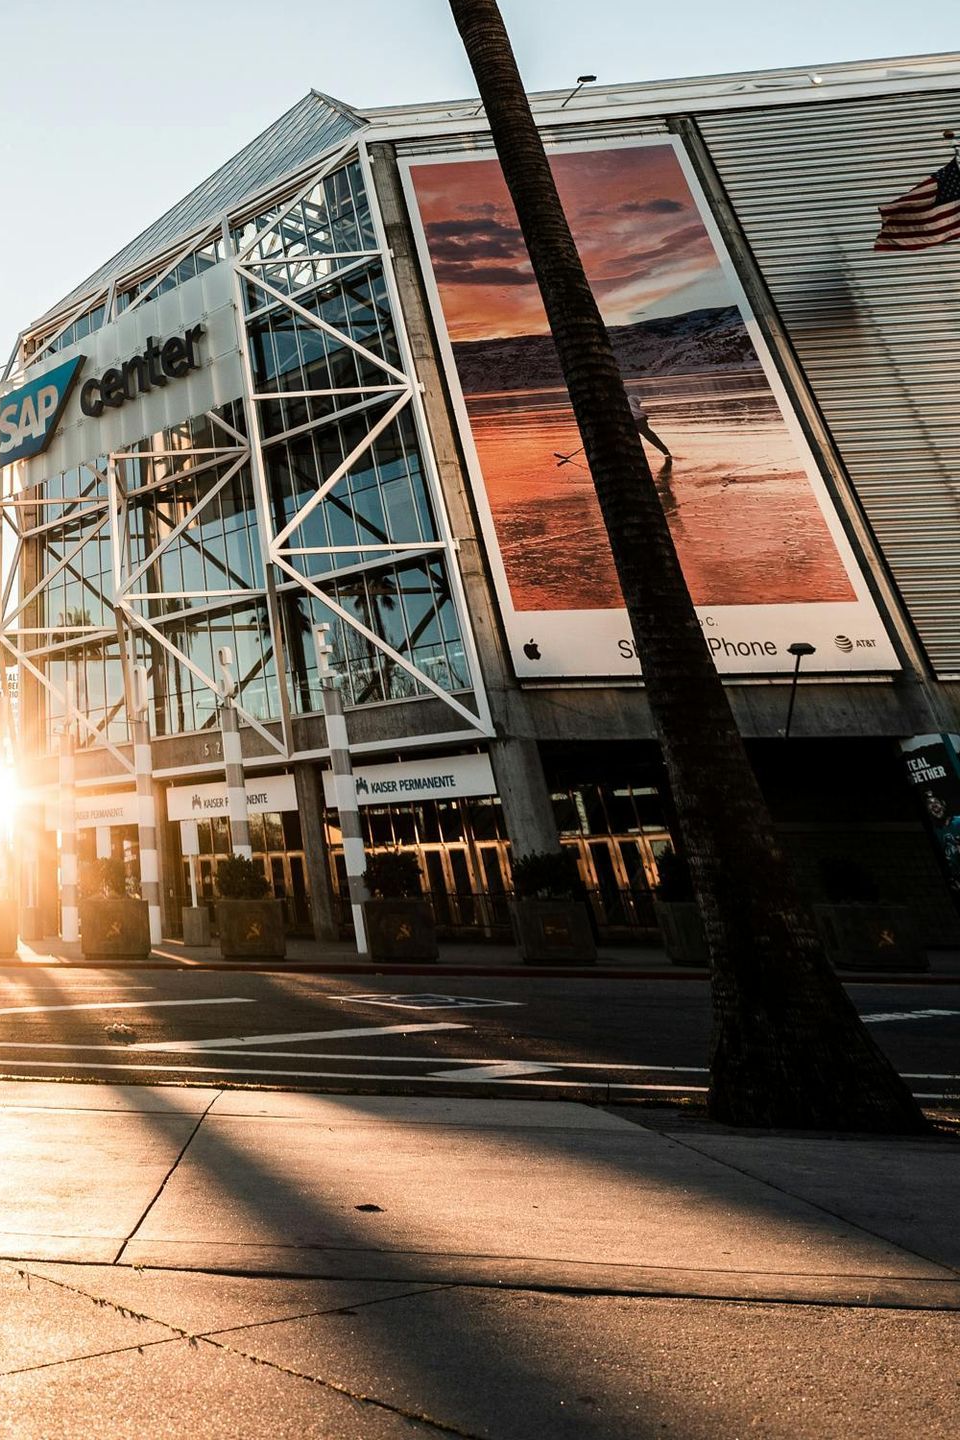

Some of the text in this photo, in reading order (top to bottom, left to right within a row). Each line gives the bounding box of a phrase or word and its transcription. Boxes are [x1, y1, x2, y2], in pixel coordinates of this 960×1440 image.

[0, 323, 206, 454] SAP center
[708, 637, 778, 657] Phone
[855, 639, 876, 648] AT&T
[371, 775, 456, 793] KAISER PERMANENTE
[203, 797, 224, 809] KAISER
